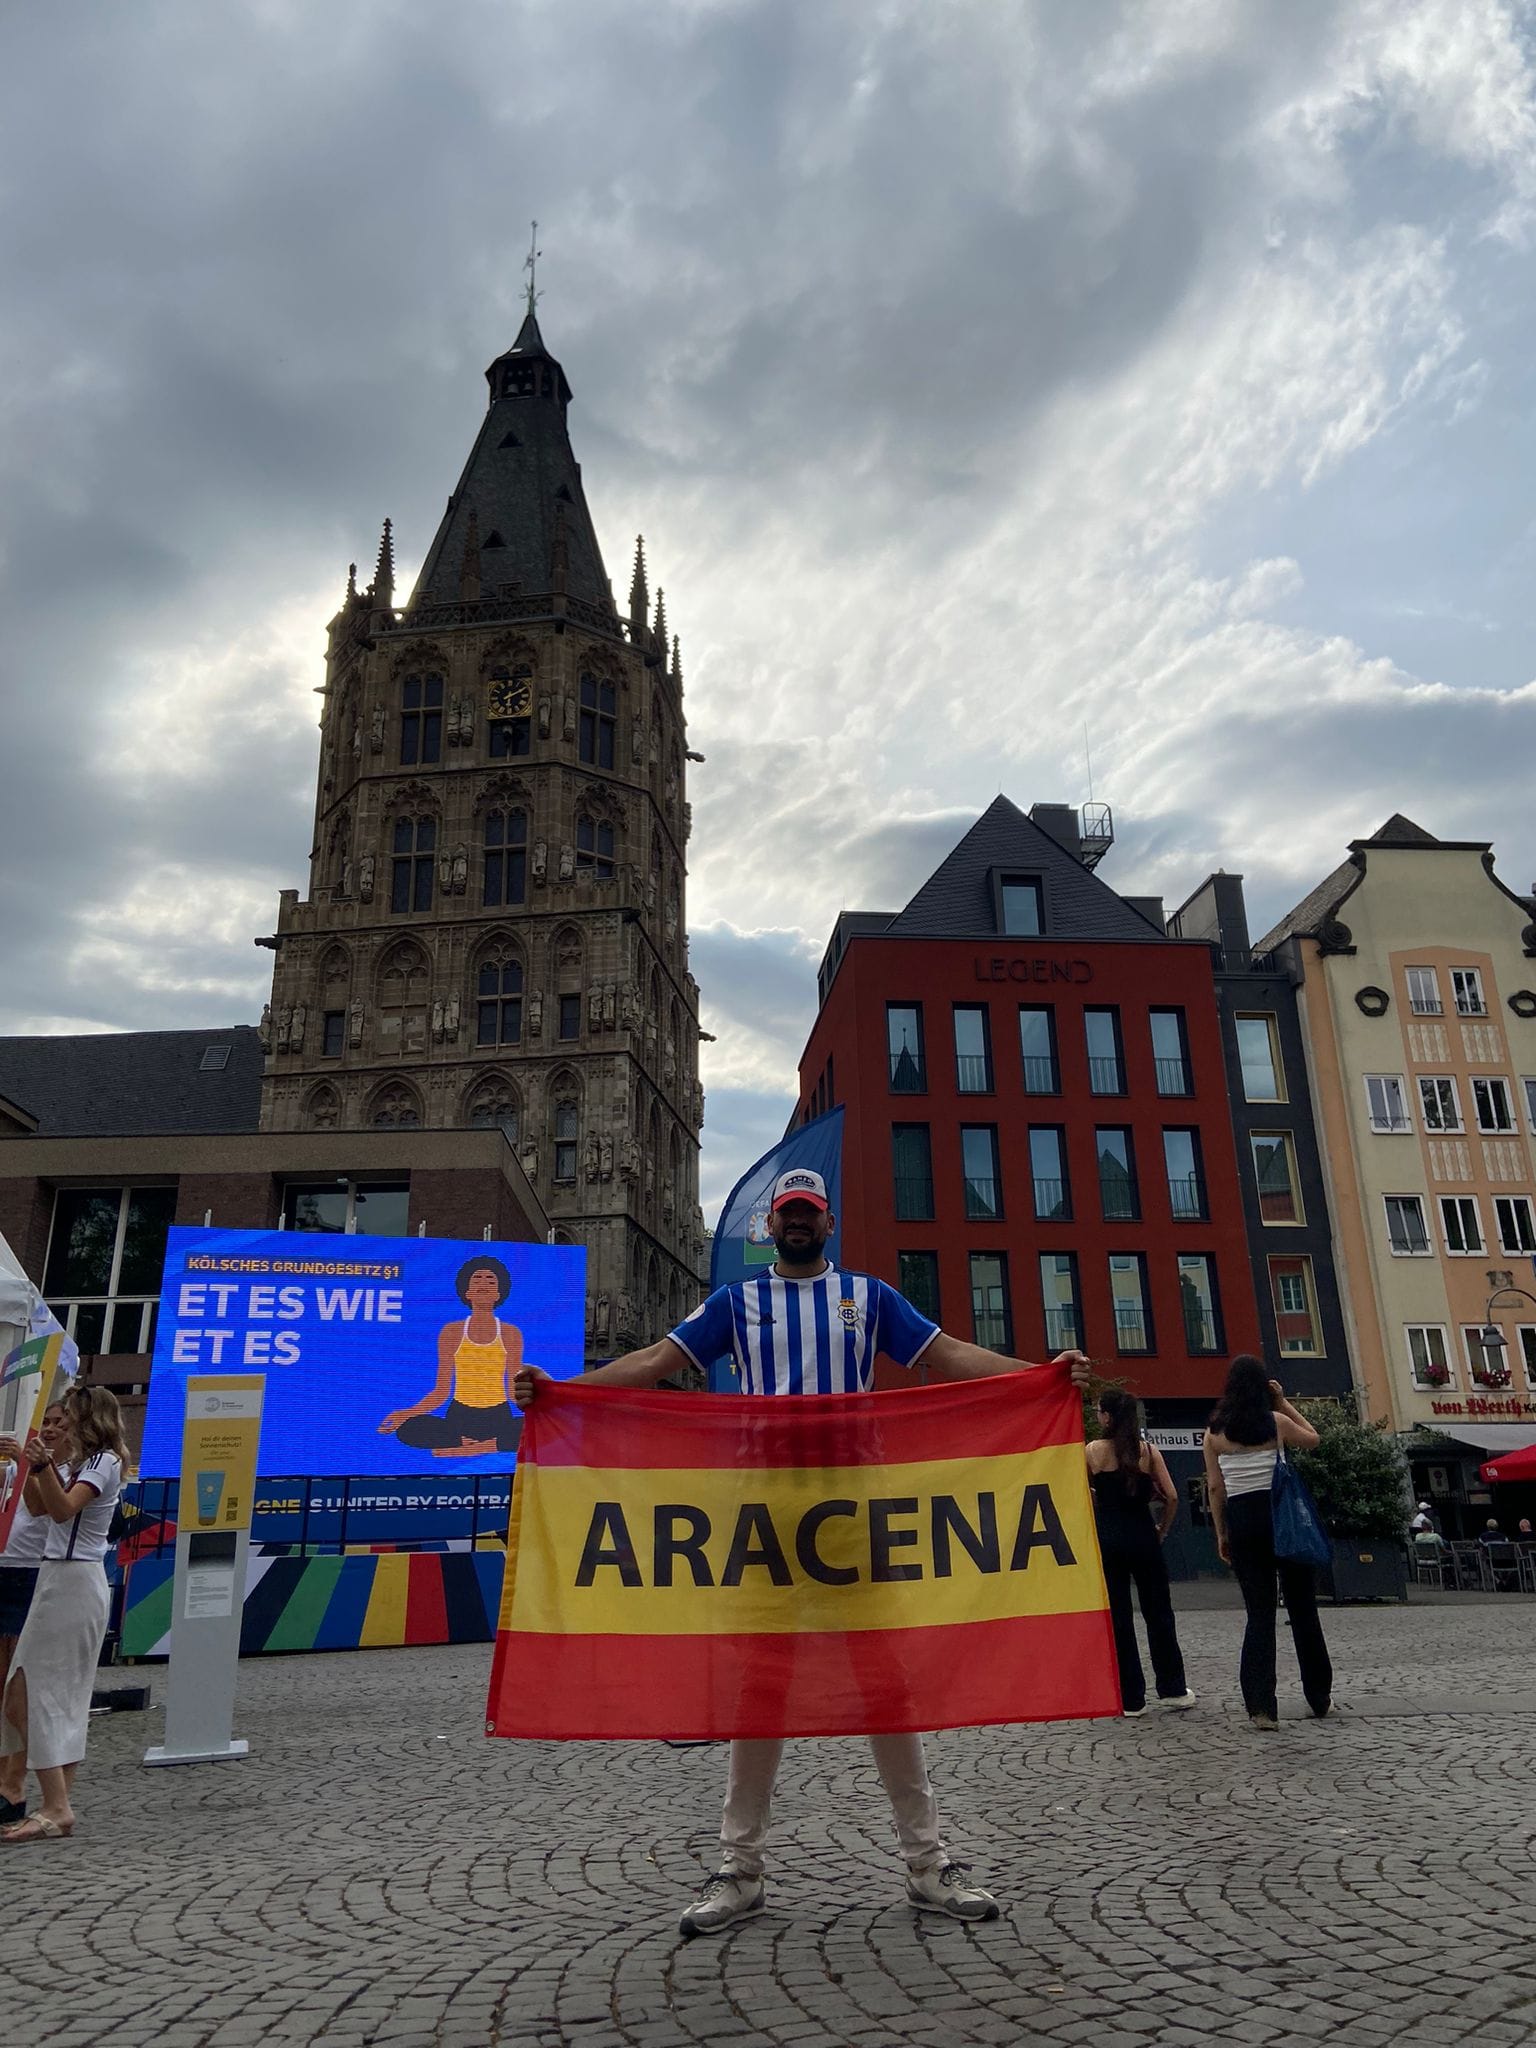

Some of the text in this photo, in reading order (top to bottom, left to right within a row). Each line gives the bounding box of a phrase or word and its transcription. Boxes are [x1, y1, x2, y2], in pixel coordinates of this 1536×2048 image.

[974, 957, 1094, 984] LEGEND
[188, 1255, 399, 1279] KÖLSCHES GRUNDGESETZ §1
[177, 1283, 404, 1322] ET ES WIE
[172, 1329, 301, 1365] ET ES
[1146, 1433, 1189, 1445] athaus
[254, 1499, 301, 1515] GNE
[327, 1496, 402, 1512] UNITED
[406, 1495, 436, 1511] BY
[574, 1483, 1078, 1587] ARACENA
